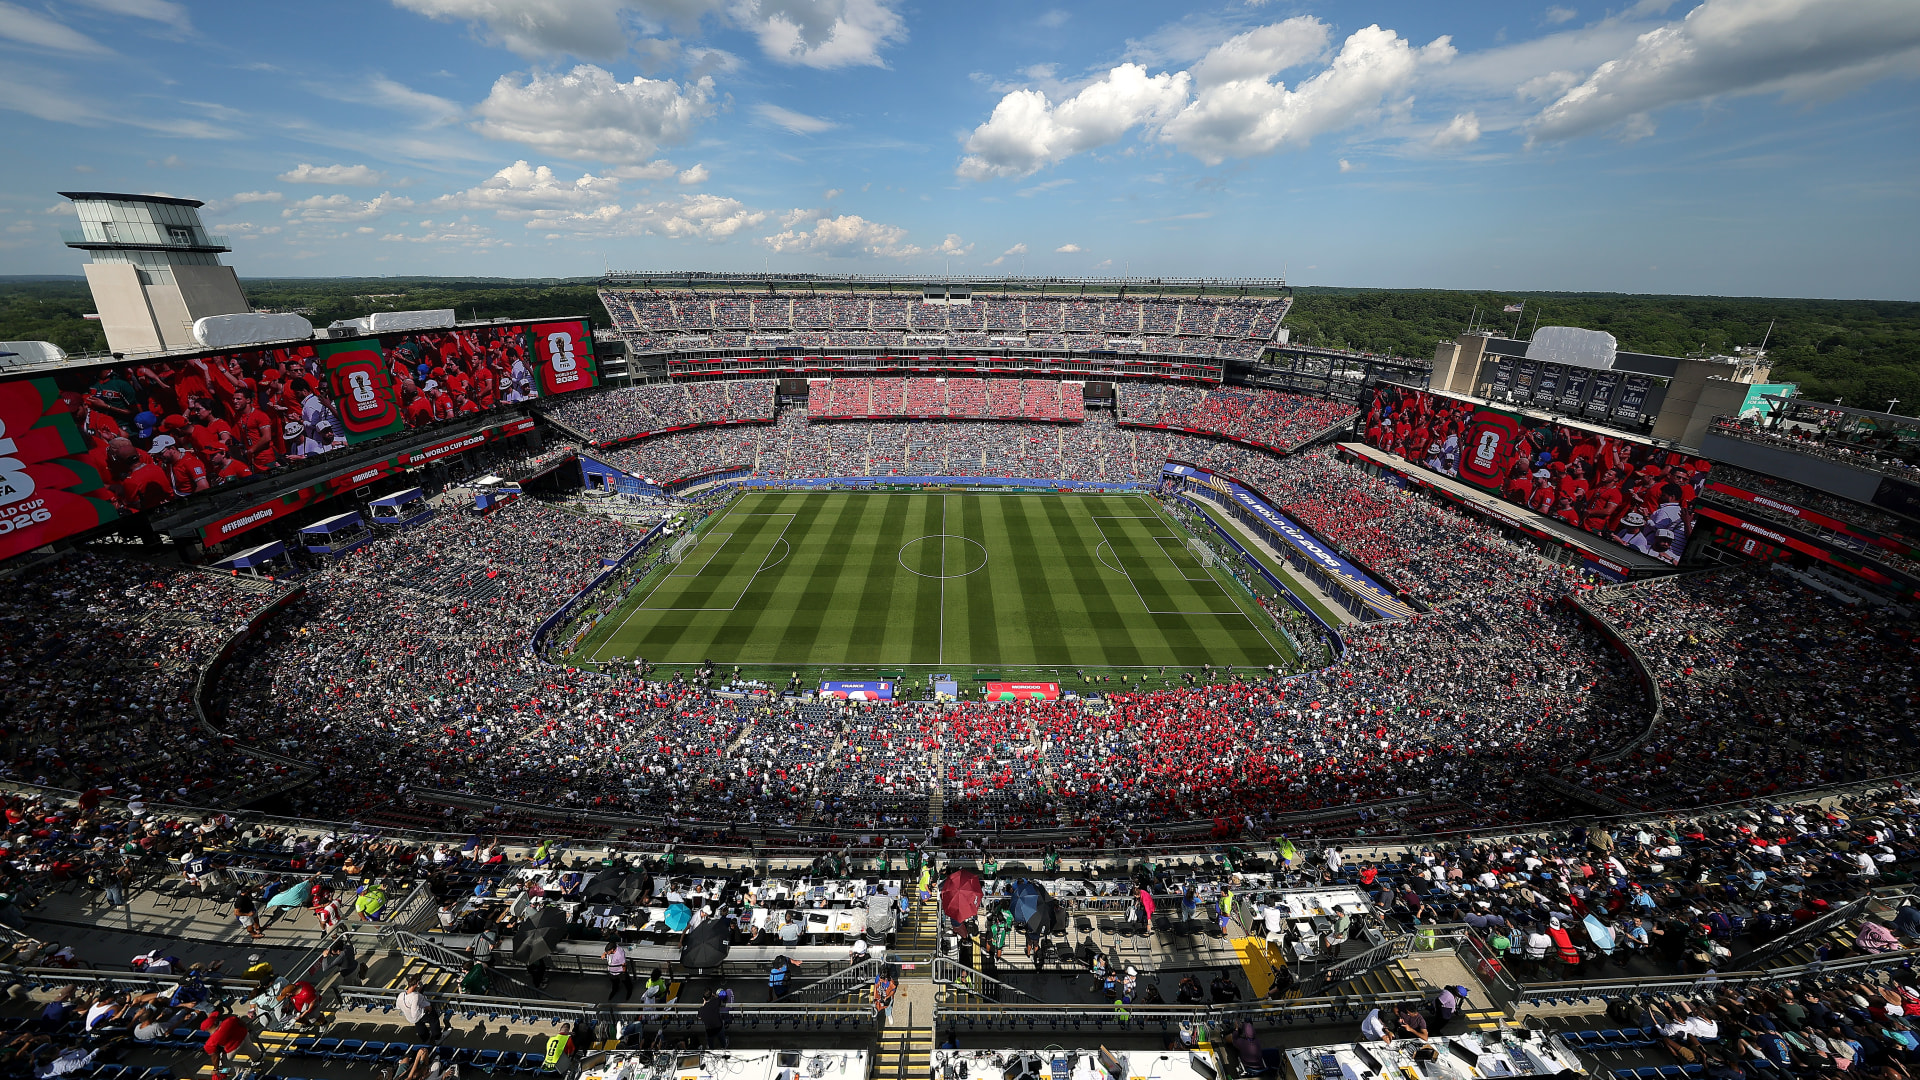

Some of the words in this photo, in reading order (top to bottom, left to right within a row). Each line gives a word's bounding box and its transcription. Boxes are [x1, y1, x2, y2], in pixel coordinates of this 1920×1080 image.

[556, 375, 579, 384] 2026
[1617, 410, 1636, 418] 2018
[410, 453, 426, 463] FIFA
[425, 446, 450, 459] WORLD
[450, 441, 463, 451] CUP
[463, 435, 485, 446] 2026
[352, 468, 379, 484] MOROCCO
[19, 498, 45, 512] CUP
[1464, 500, 1474, 508] FIFA
[1474, 504, 1492, 515] WORLD
[1501, 516, 1520, 528] 2026
[1754, 496, 1800, 516] #FIFAWorldCup
[221, 508, 273, 534] #FIFAWorldCup
[1236, 493, 1256, 505] FIFA
[1252, 504, 1286, 526] WORLD
[1281, 525, 1305, 541] CUP
[1298, 539, 1341, 567] 2026
[1741, 522, 1786, 543] #FIFAWorldCup
[191, 863, 203, 873] 10
